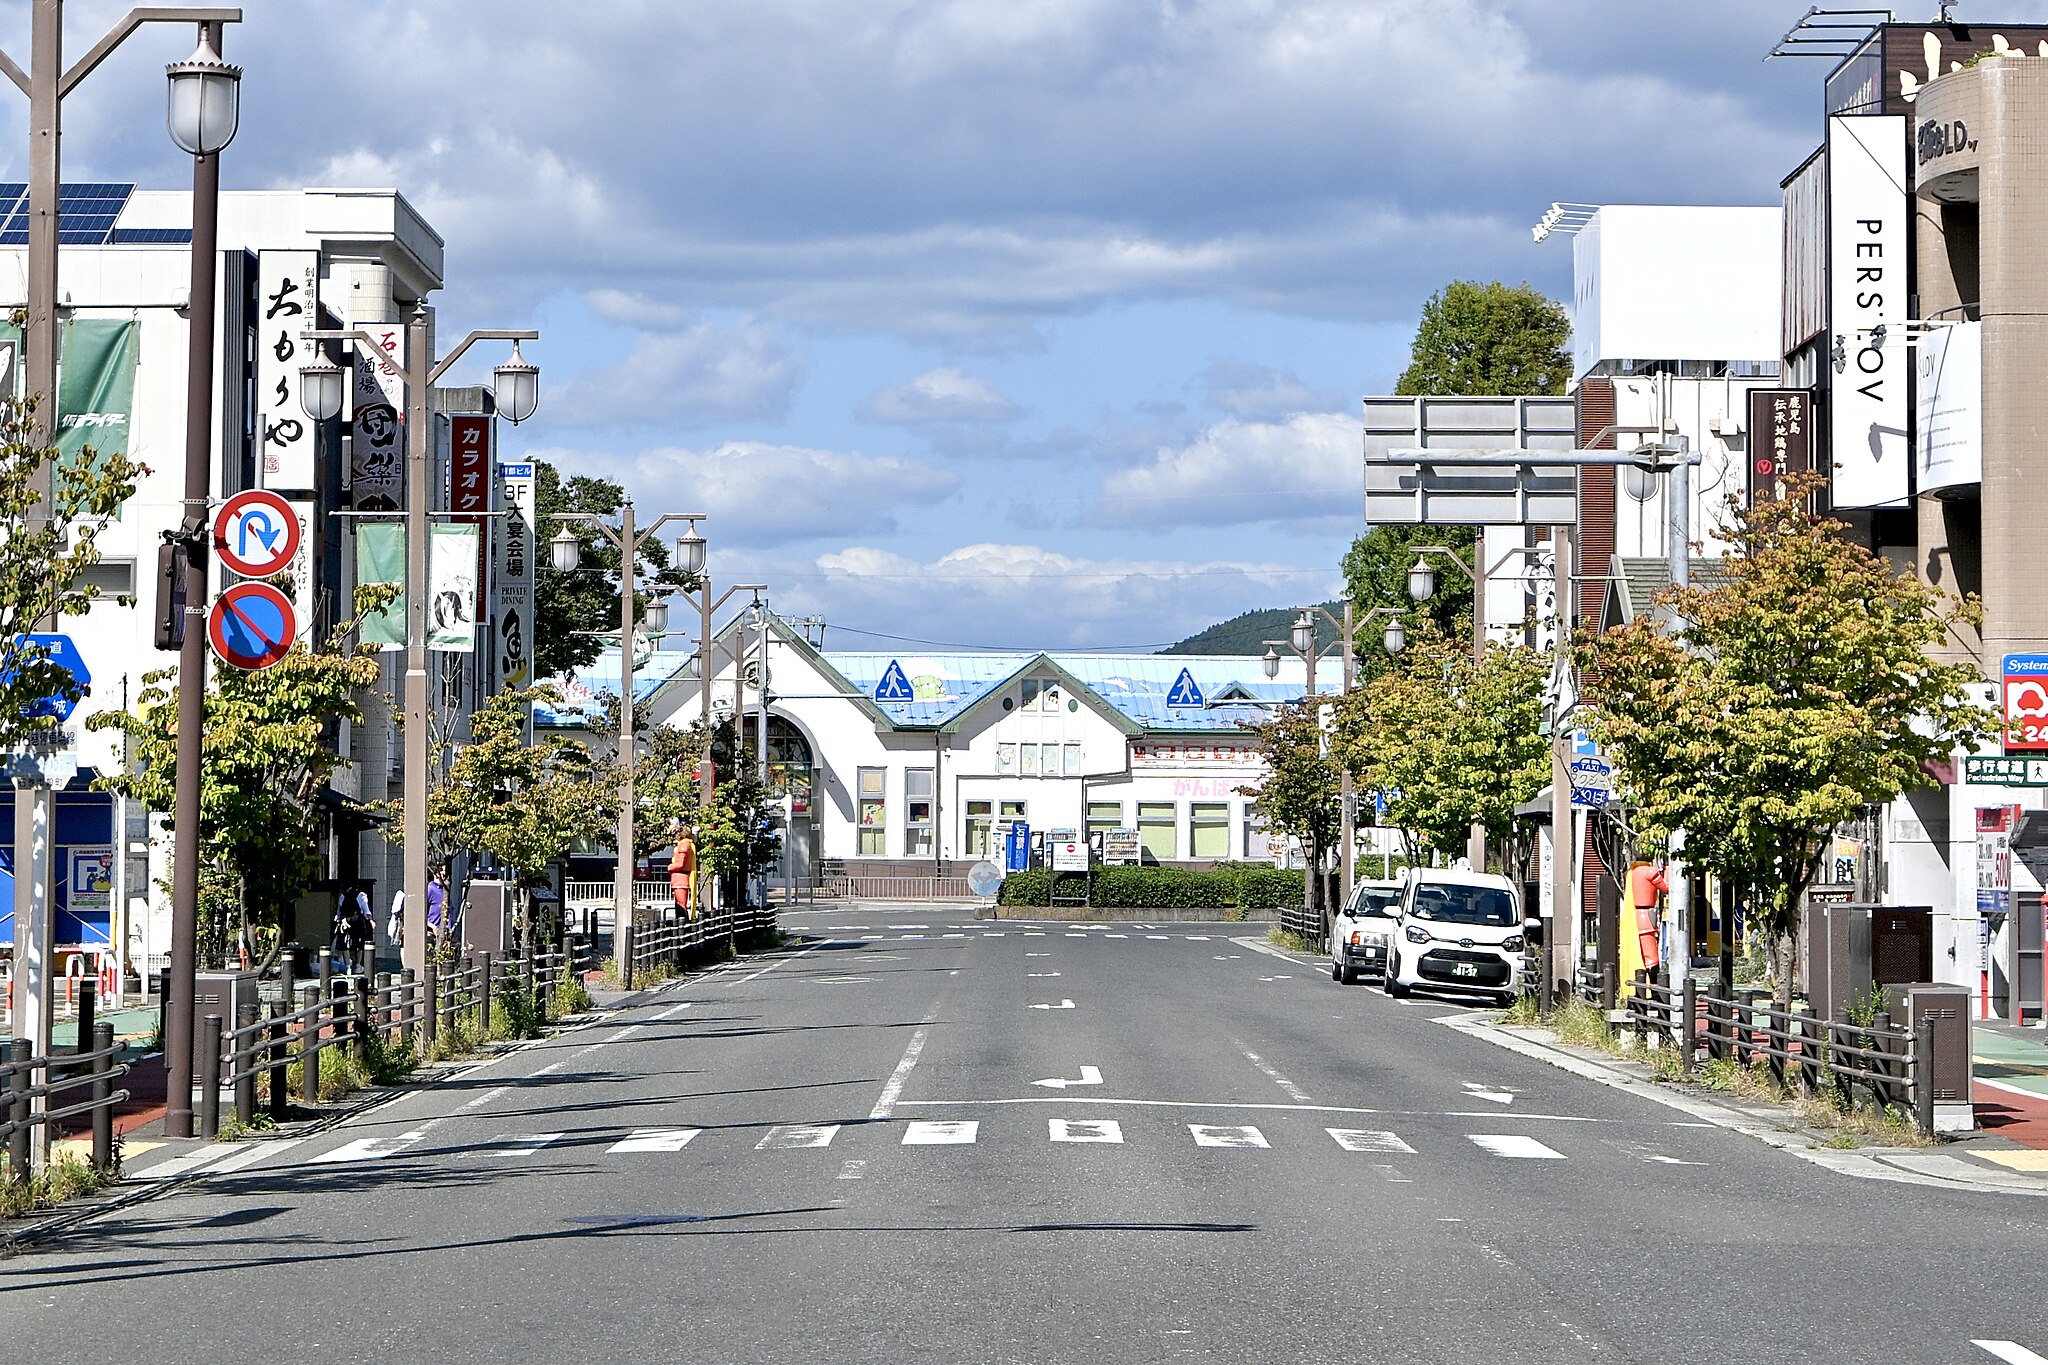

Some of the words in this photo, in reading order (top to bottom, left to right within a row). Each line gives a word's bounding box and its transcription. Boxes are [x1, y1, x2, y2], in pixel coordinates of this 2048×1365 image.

[304, 267, 315, 352] 創業明治二十年
[1789, 396, 1801, 434] 鹿児島
[460, 428, 480, 509] カラオケ
[504, 485, 528, 500] 3F
[506, 503, 524, 577] 大宴会場
[501, 587, 528, 596] PRIVATE
[501, 596, 524, 605] DINING
[1581, 763, 1600, 772] TAXI
[1967, 760, 2025, 774] 歩行者道
[1967, 774, 2007, 783] Pedestrian
[2008, 774, 2025, 784] Way
